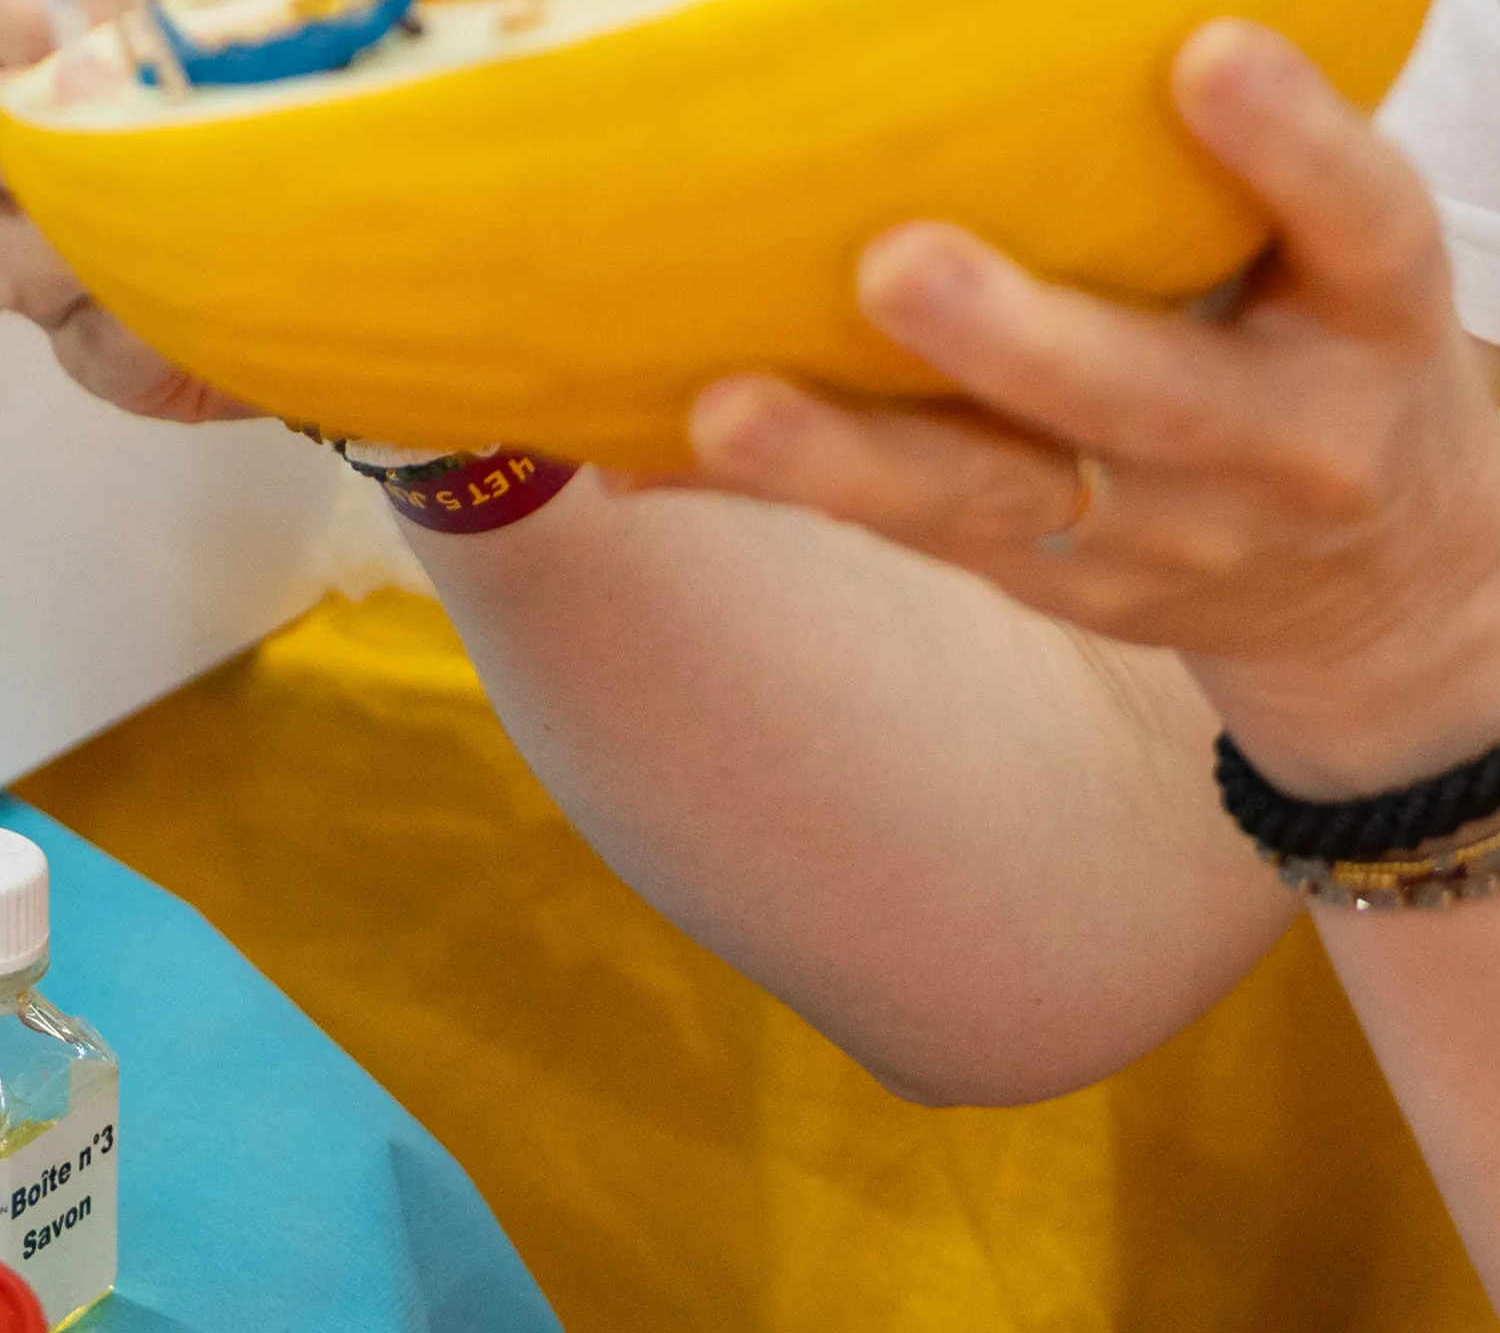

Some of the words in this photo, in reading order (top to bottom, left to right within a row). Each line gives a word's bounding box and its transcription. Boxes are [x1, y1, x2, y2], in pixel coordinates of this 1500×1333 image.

[11, 1161, 72, 1221] Boîte
[79, 1124, 114, 1172] n°3
[22, 1194, 91, 1261] Savon
